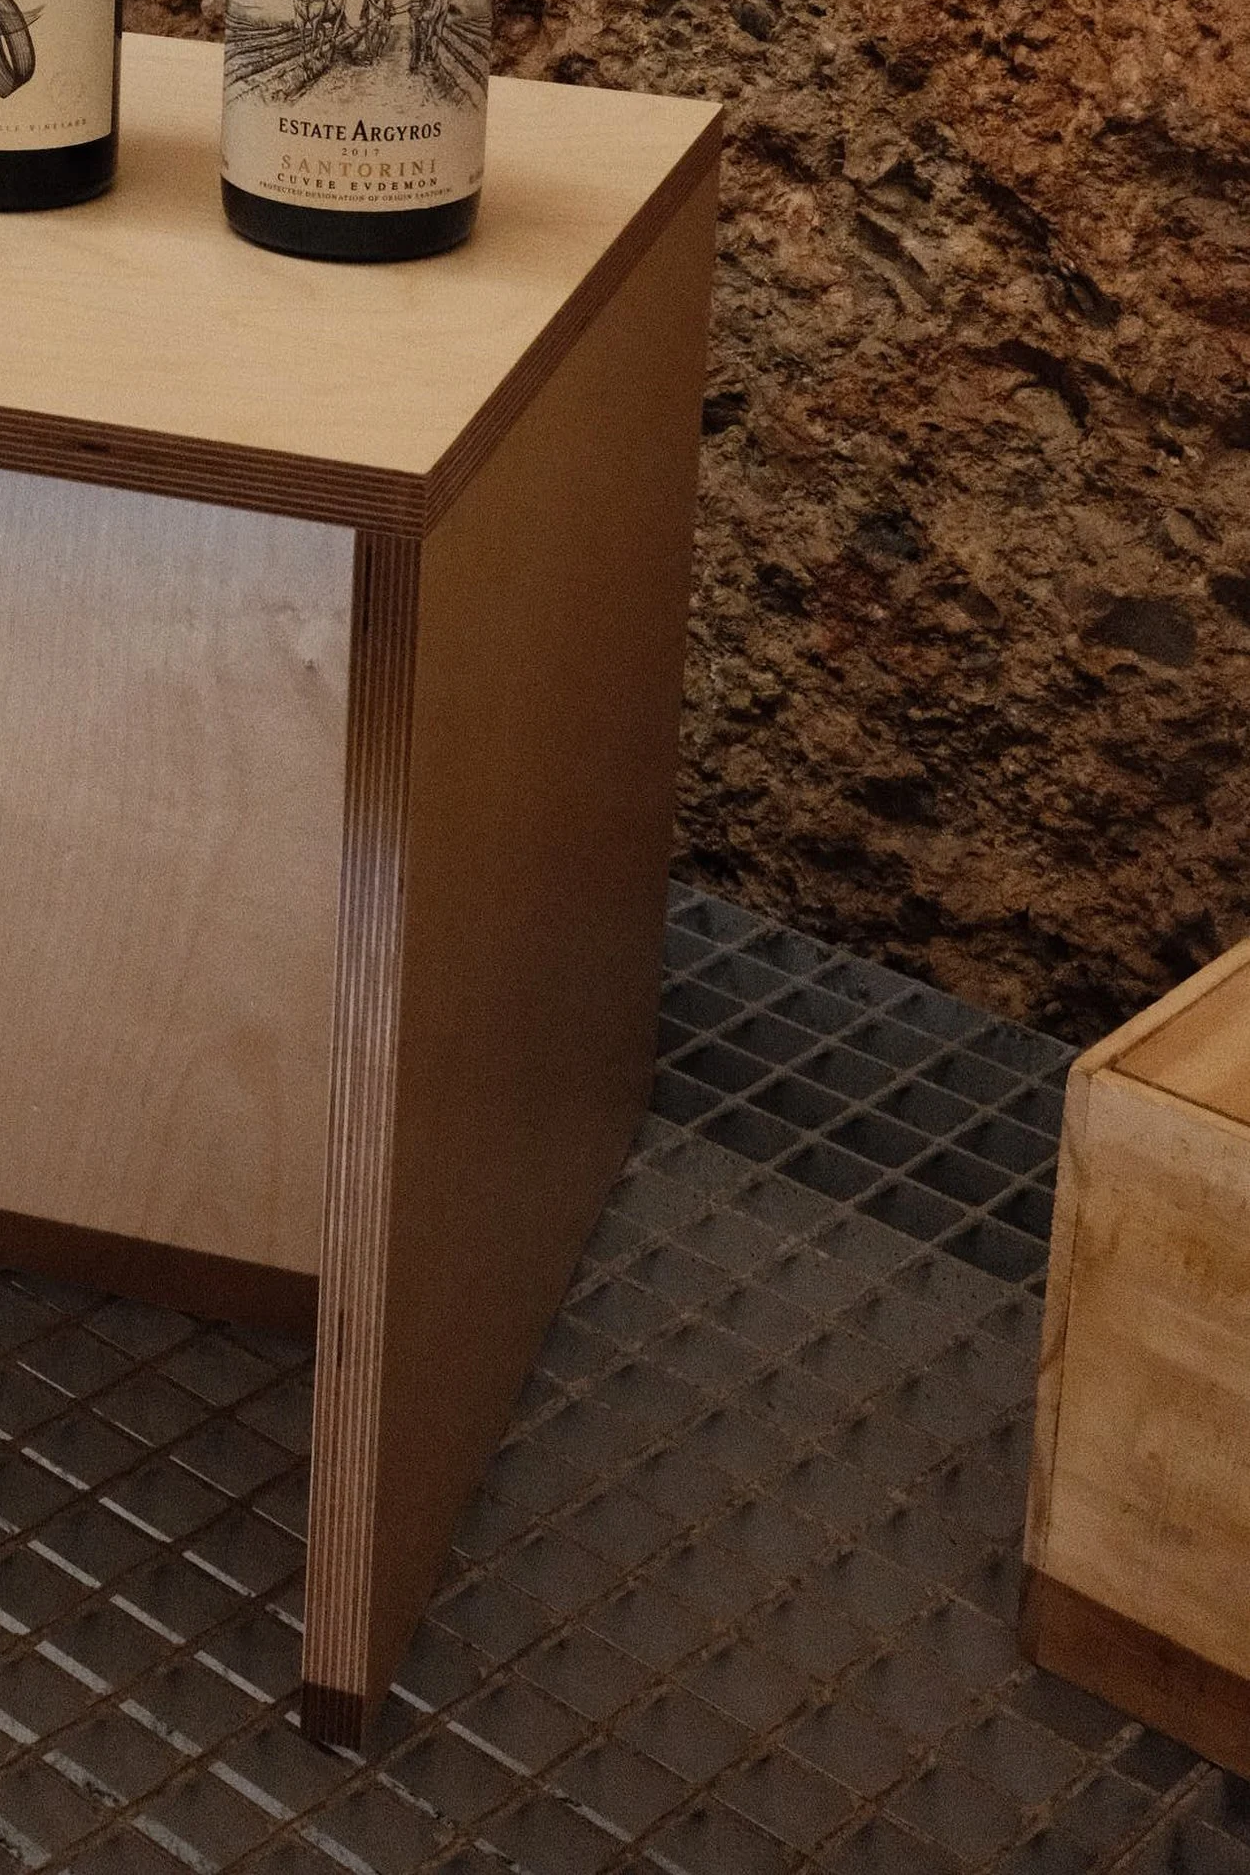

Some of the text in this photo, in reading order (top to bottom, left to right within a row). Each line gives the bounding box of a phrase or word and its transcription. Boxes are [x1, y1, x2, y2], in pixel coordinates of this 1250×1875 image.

[279, 117, 442, 142] ESTATE ARGYROS
[341, 147, 380, 157] 2017
[281, 153, 436, 178] SANTORINI
[259, 180, 302, 196] PROTECTED
[305, 190, 365, 202] DESIGNATION
[382, 194, 412, 202] ORIGIN
[277, 173, 438, 191] CUVEE EVDEMON
